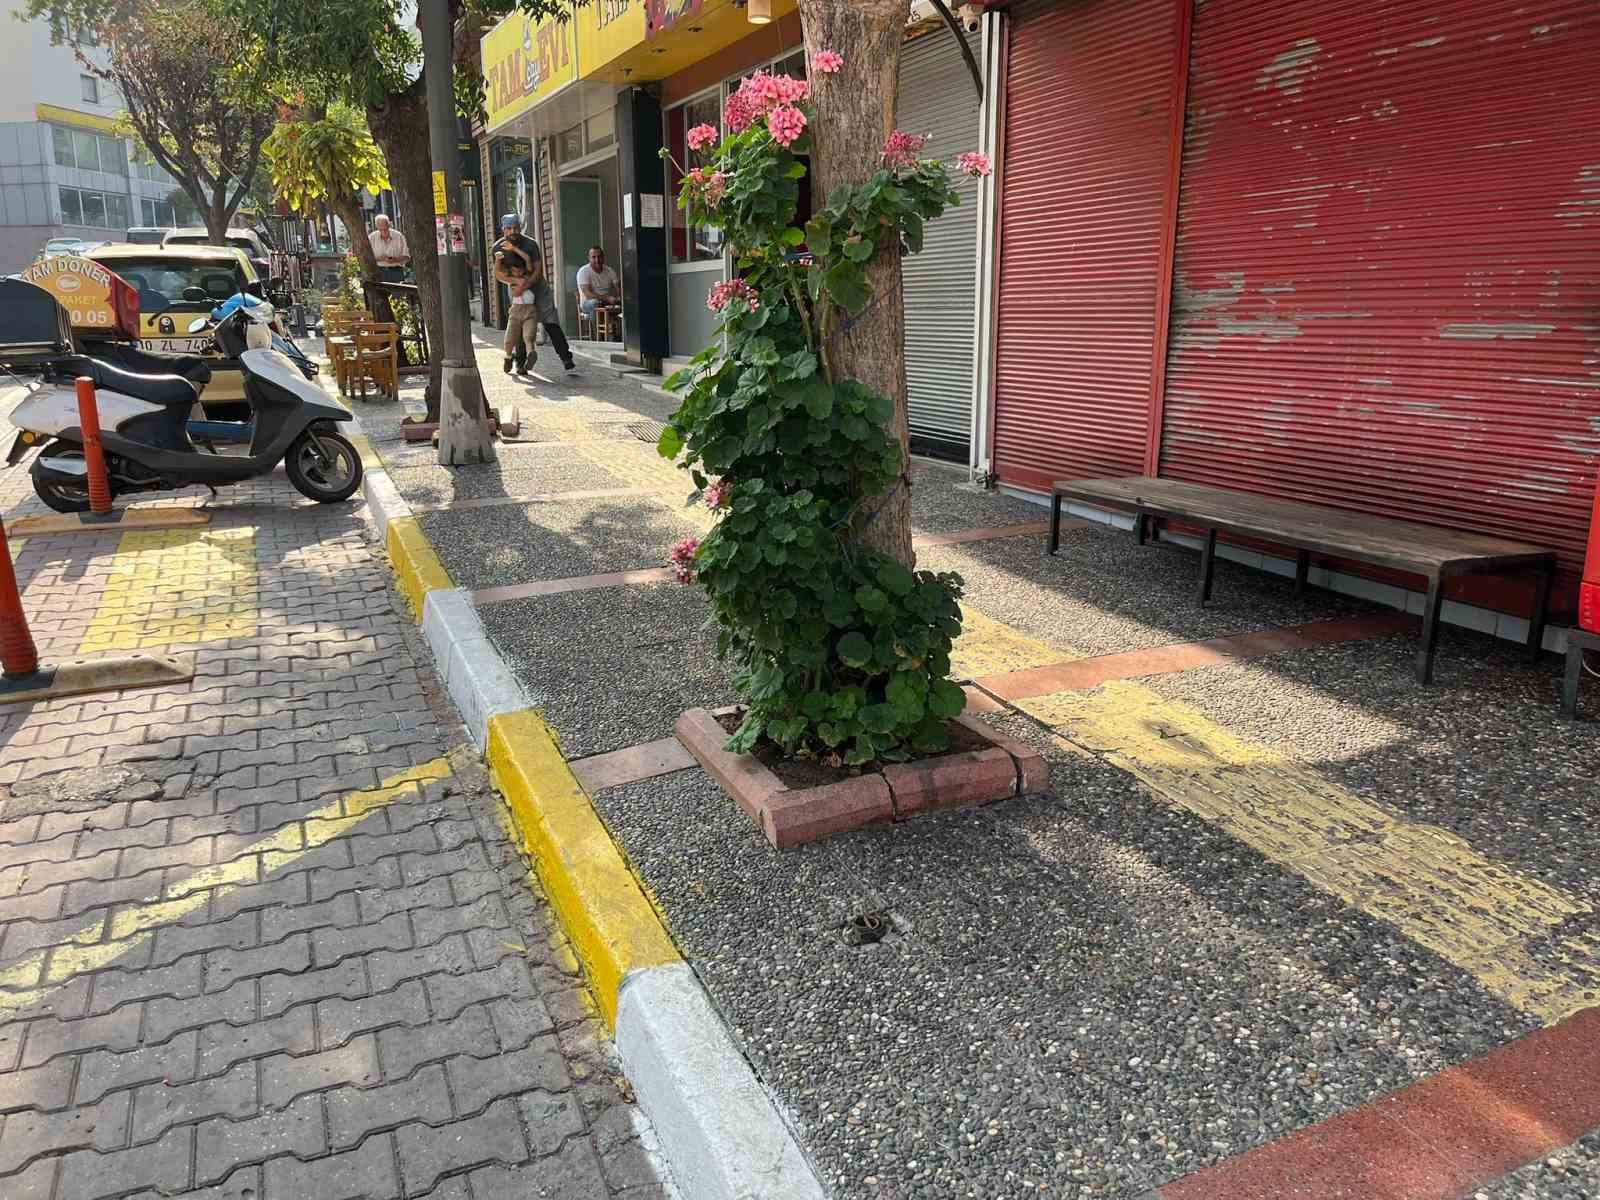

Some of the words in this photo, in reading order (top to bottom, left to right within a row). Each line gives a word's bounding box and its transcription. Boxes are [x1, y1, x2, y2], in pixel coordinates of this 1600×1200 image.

[489, 47, 522, 113] TAM
[86, 310, 107, 324] 05
[160, 340, 177, 351] ZL
